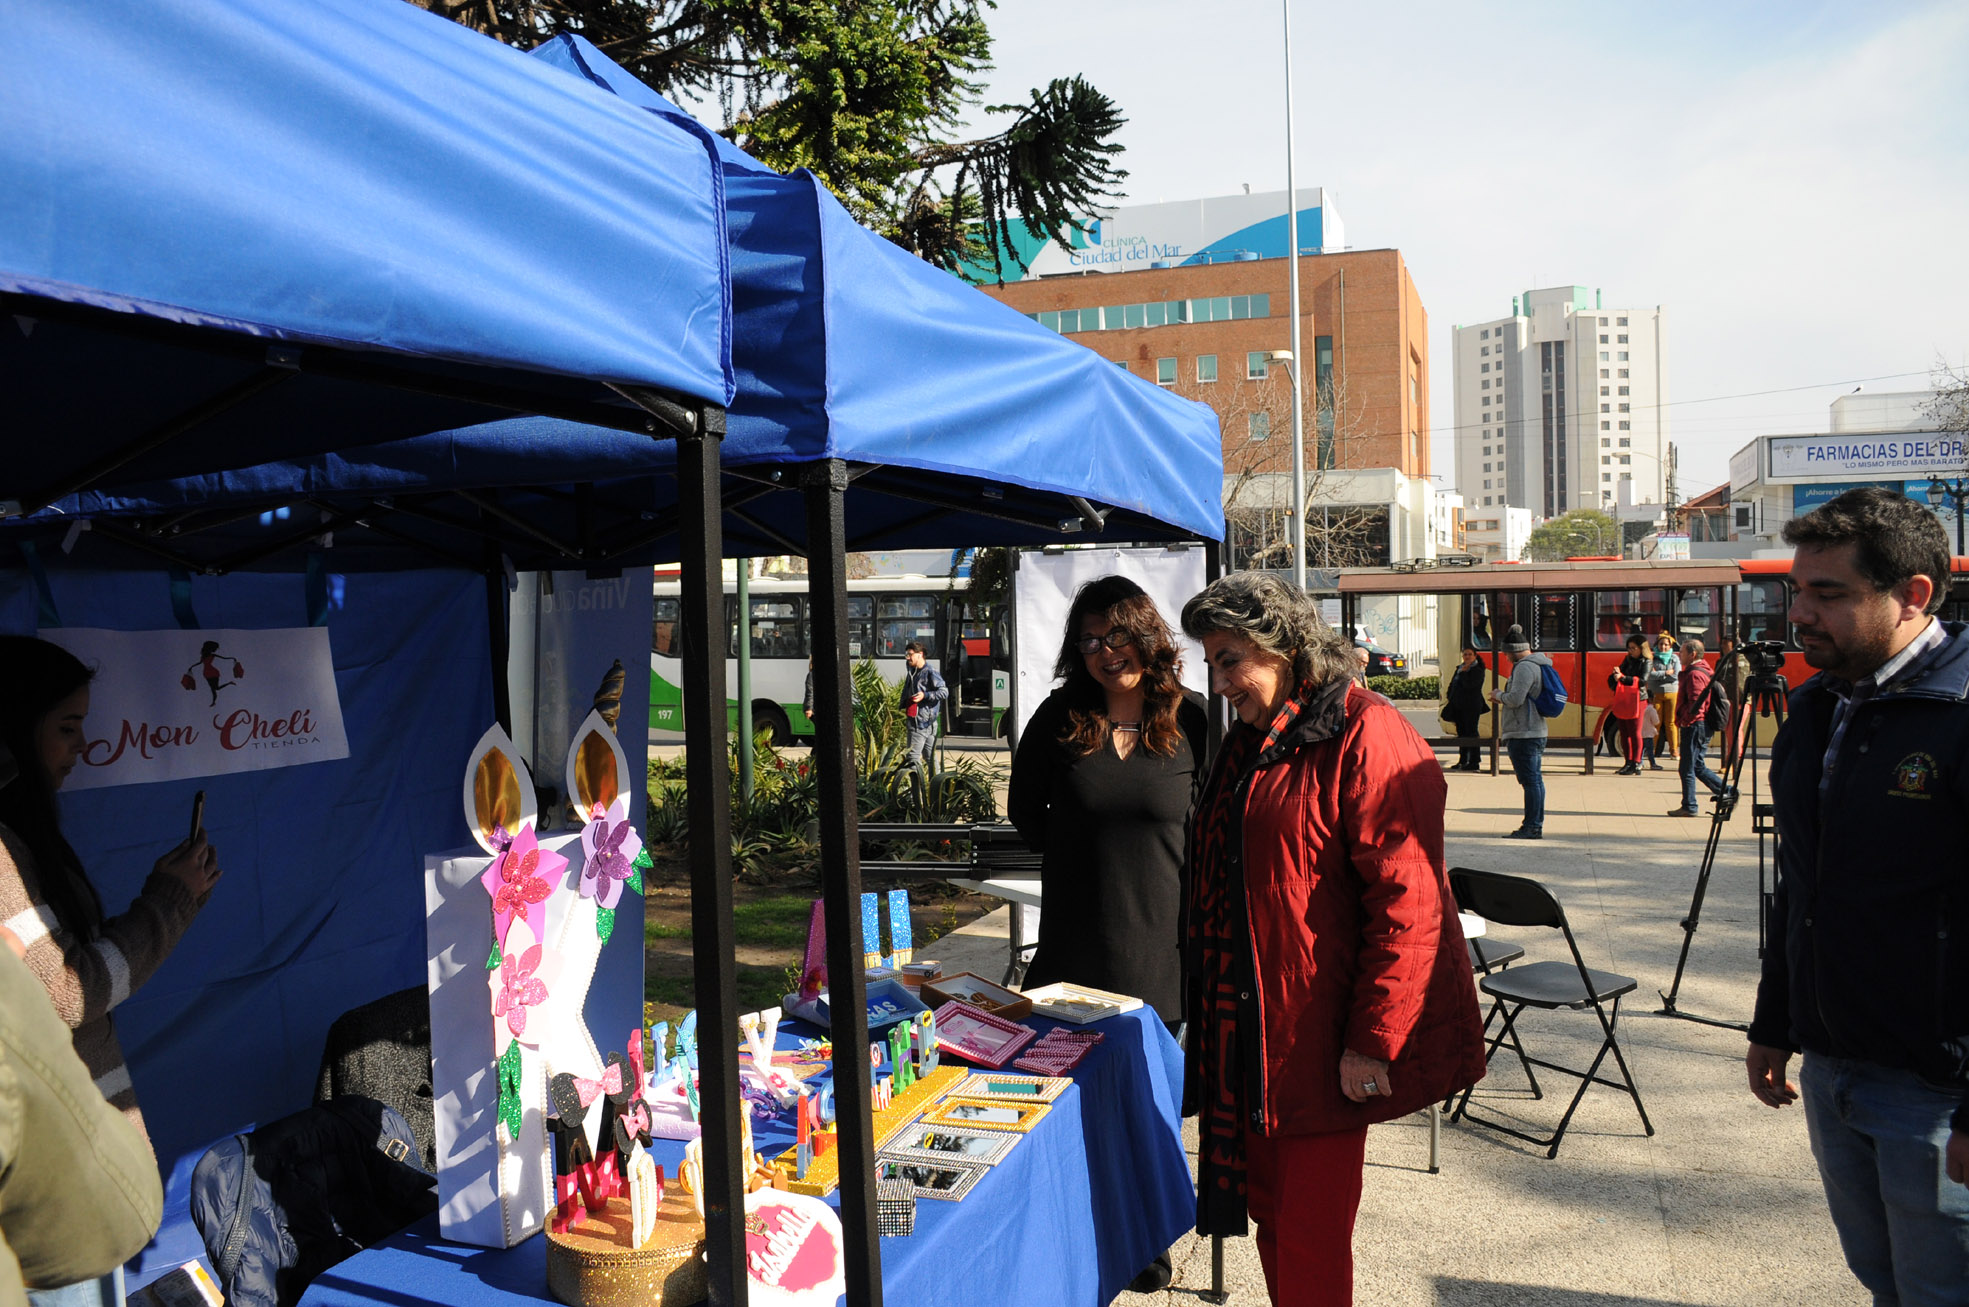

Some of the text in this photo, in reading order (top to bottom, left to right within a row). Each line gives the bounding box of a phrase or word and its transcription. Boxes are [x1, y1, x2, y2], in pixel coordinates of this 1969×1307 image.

[1103, 235, 1147, 248] CLÍNICA
[1070, 243, 1182, 266] Ciudad del Mar
[1807, 443, 1898, 462] FARMACIAS
[1903, 442, 1932, 458] DEL
[1858, 460, 1885, 468] MISMO
[1887, 459, 1909, 467] PERO
[657, 709, 673, 720] 197
[82, 708, 318, 767] Mon Chelí
[251, 736, 322, 750] TIENDA
